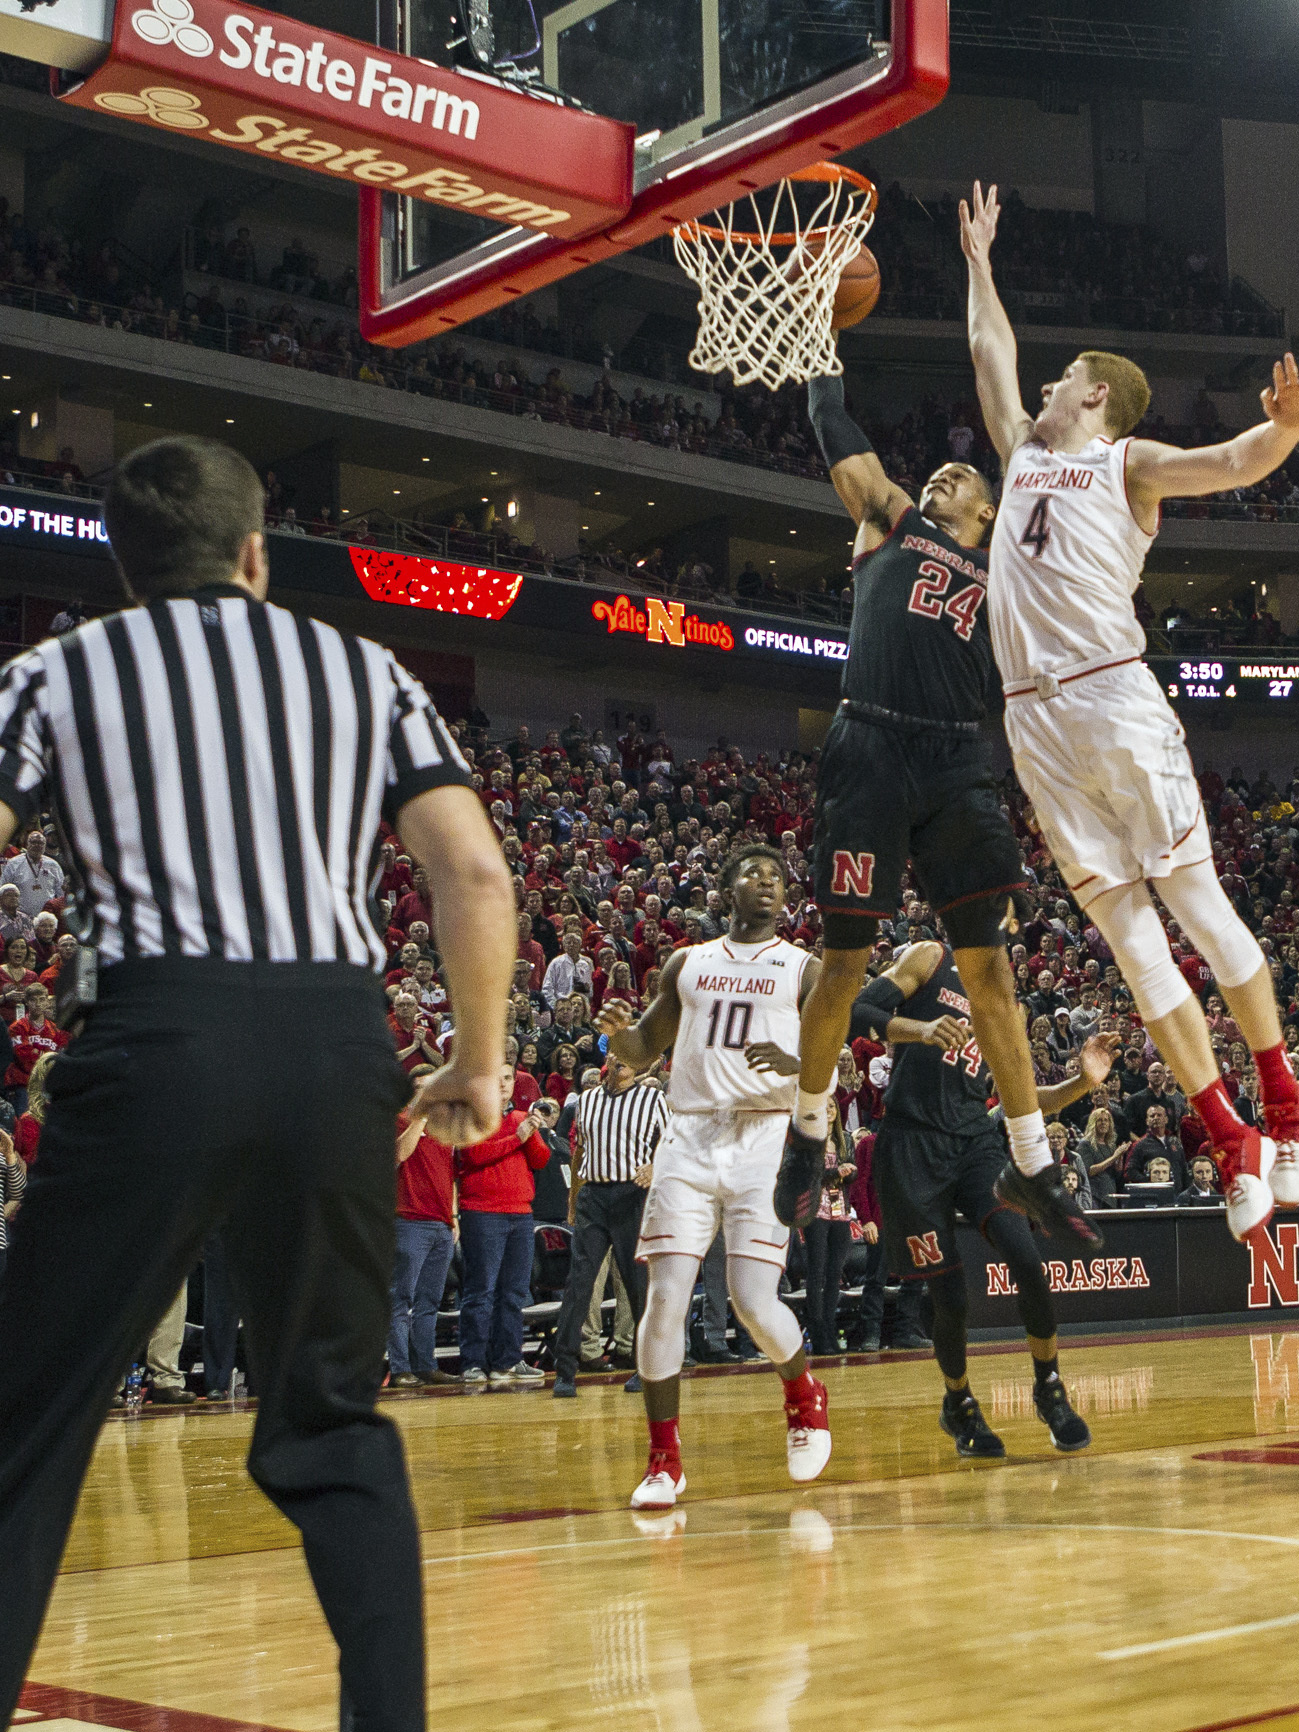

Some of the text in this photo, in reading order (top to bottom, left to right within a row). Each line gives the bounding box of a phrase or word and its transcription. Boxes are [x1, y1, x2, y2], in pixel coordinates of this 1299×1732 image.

[1010, 467, 1094, 493] MARYLAND
[28, 510, 75, 538] THE
[1019, 495, 1053, 559] 4
[907, 559, 986, 642] 24
[745, 627, 850, 660] OFFICIAL PIZZ
[1168, 684, 1179, 698] 3
[1225, 684, 1237, 698] 4
[1268, 680, 1294, 697] 27
[1179, 662, 1224, 681] 3:50
[831, 849, 876, 898] N
[695, 974, 776, 996] MARYLAND
[706, 998, 754, 1050] 10
[905, 1229, 945, 1268] N
[986, 1256, 1150, 1296] NRASKA
